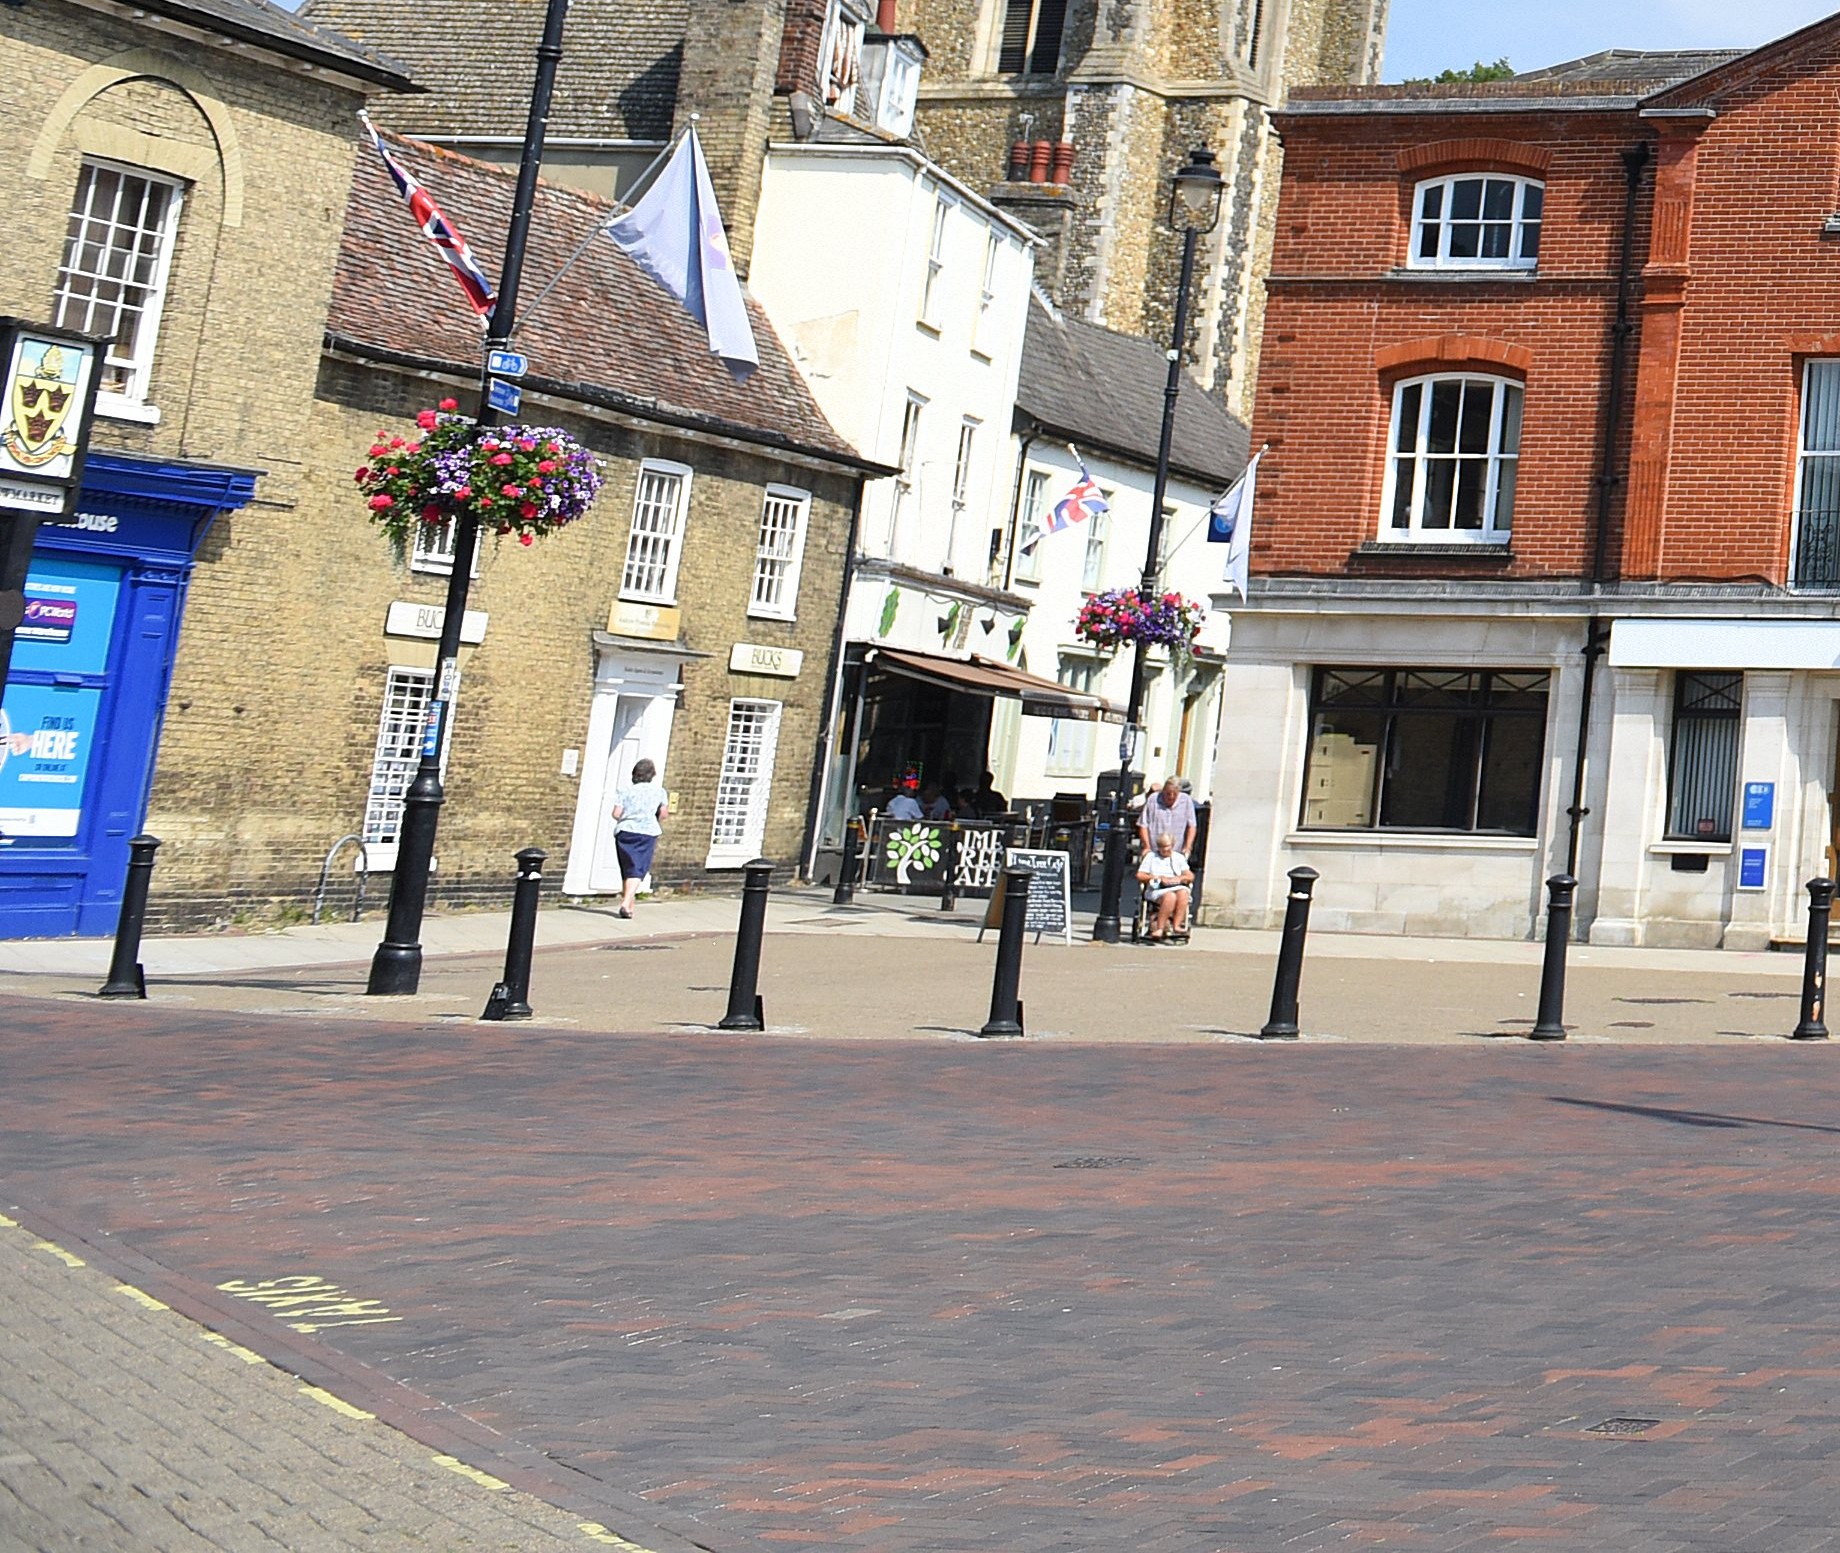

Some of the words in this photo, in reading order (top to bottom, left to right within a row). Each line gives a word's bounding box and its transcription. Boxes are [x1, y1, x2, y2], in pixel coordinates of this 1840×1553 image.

[752, 648, 782, 670] BUCKS
[29, 730, 80, 760] HERE
[957, 849, 1005, 869] REE
